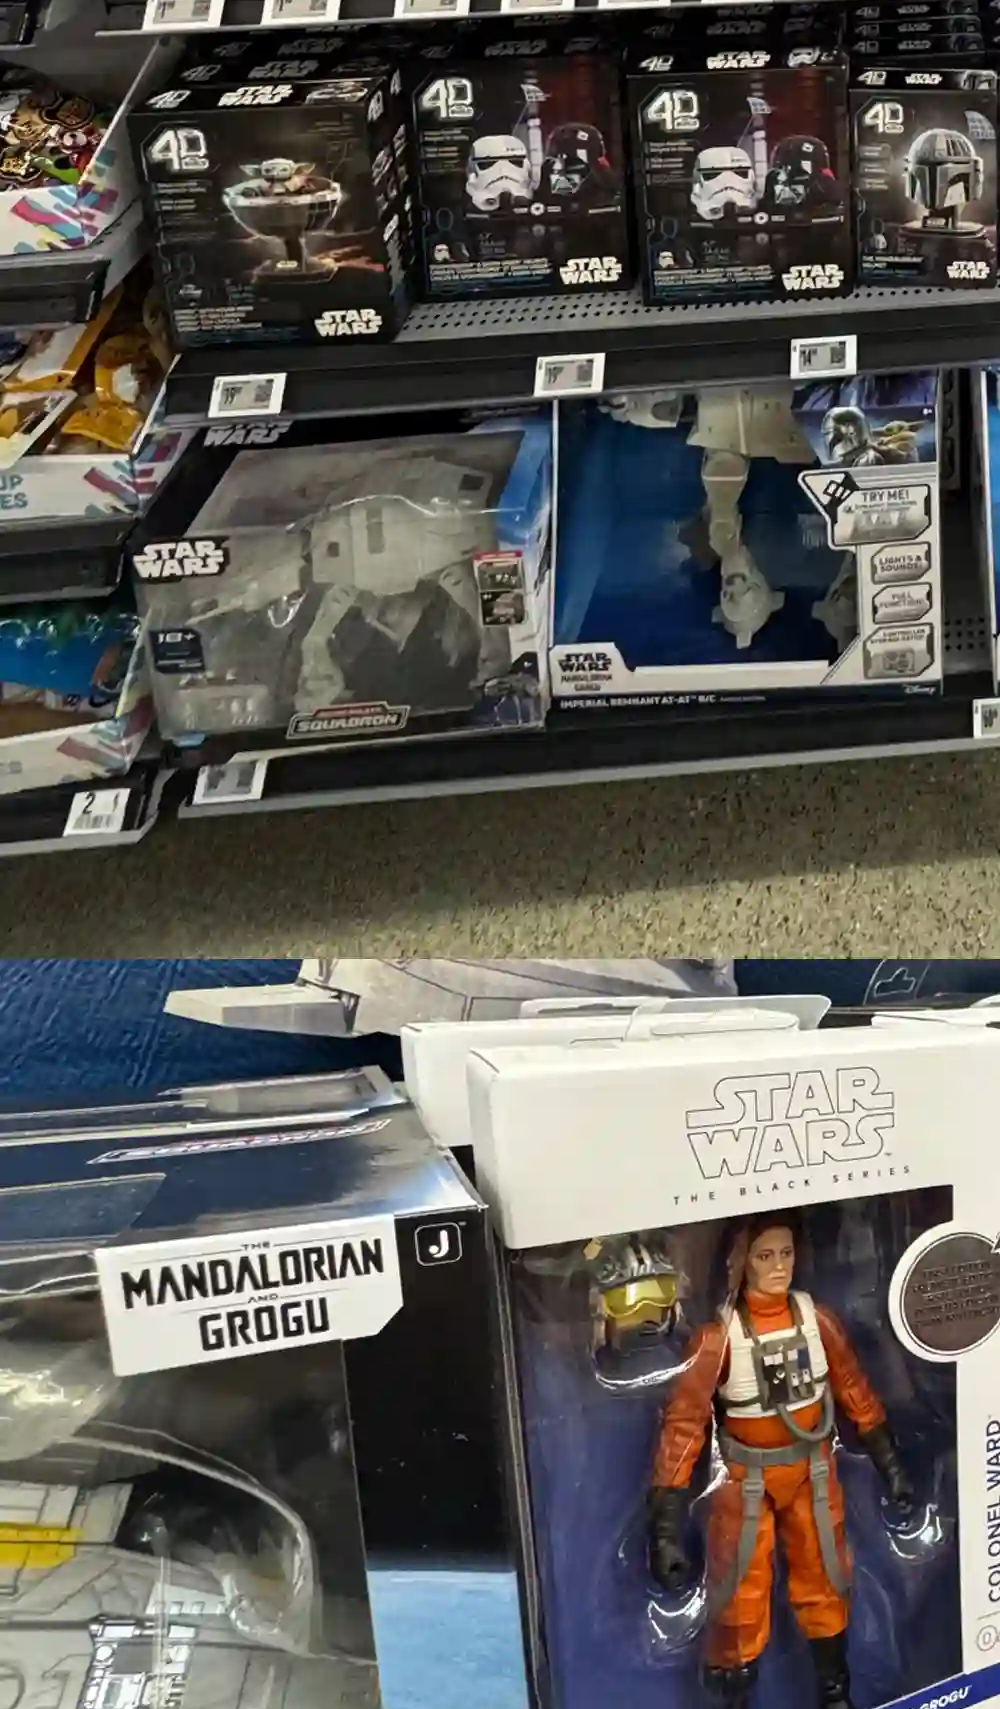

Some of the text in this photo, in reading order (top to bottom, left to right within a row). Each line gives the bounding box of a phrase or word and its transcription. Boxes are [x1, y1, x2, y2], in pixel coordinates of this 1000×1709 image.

[861, 489, 909, 502] TRY ME!
[560, 698, 610, 708] IMPERIAL
[296, 711, 399, 733] SQUADRON
[685, 1065, 895, 1128] STAR
[686, 1111, 895, 1179] WARS
[673, 1164, 912, 1206] THE BLACK SERIES
[241, 1241, 271, 1252] THE
[120, 1238, 385, 1310] MANDALORIAN
[247, 1293, 279, 1304] AND
[199, 1297, 331, 1352] GROGU
